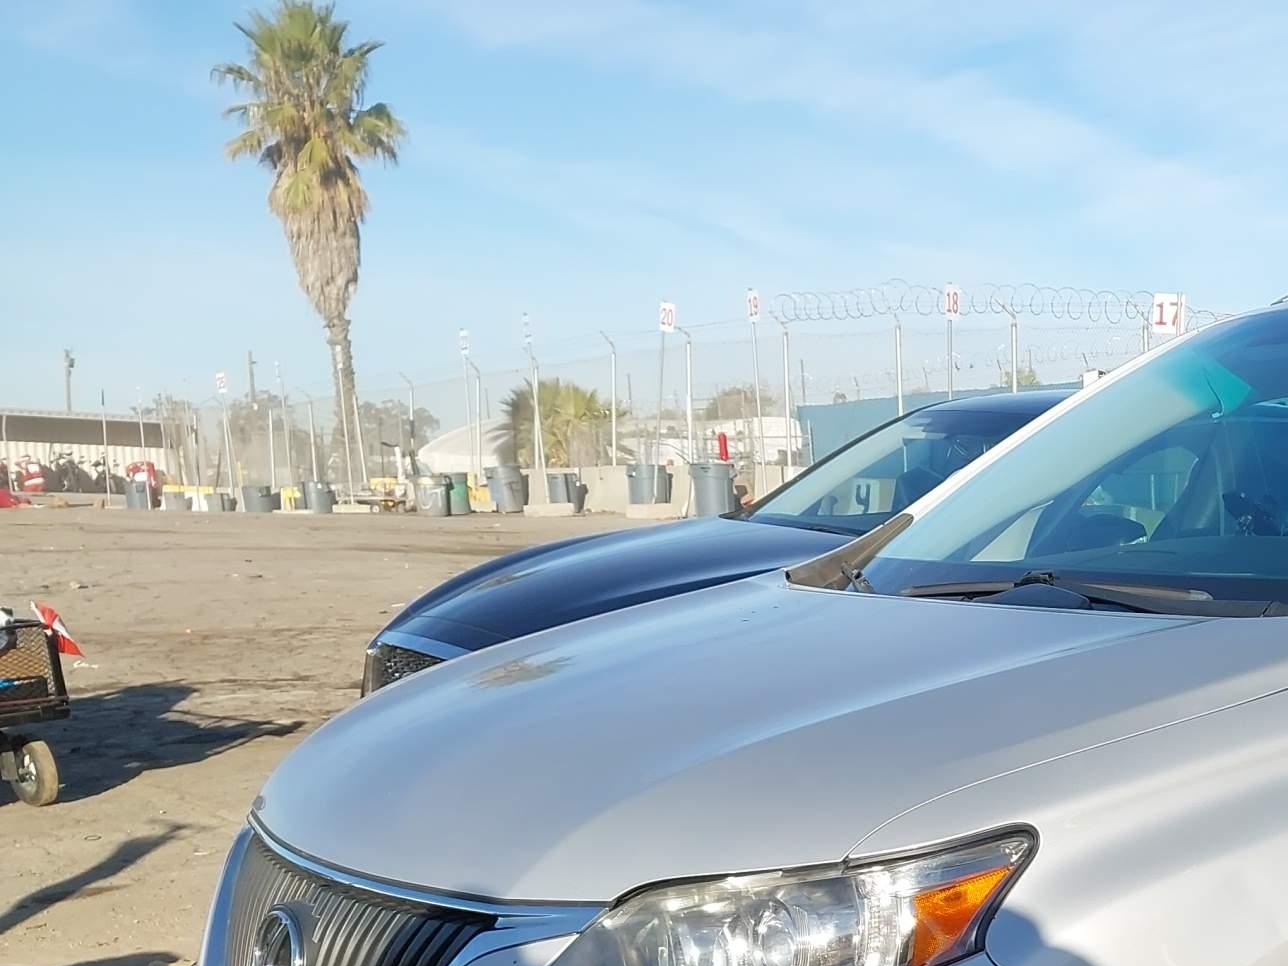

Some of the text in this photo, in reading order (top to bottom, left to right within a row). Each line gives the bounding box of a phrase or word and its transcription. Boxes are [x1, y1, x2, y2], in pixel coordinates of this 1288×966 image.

[748, 296, 758, 316] 19
[946, 291, 959, 314] 18
[660, 307, 674, 327] 20
[1155, 301, 1182, 326] 17
